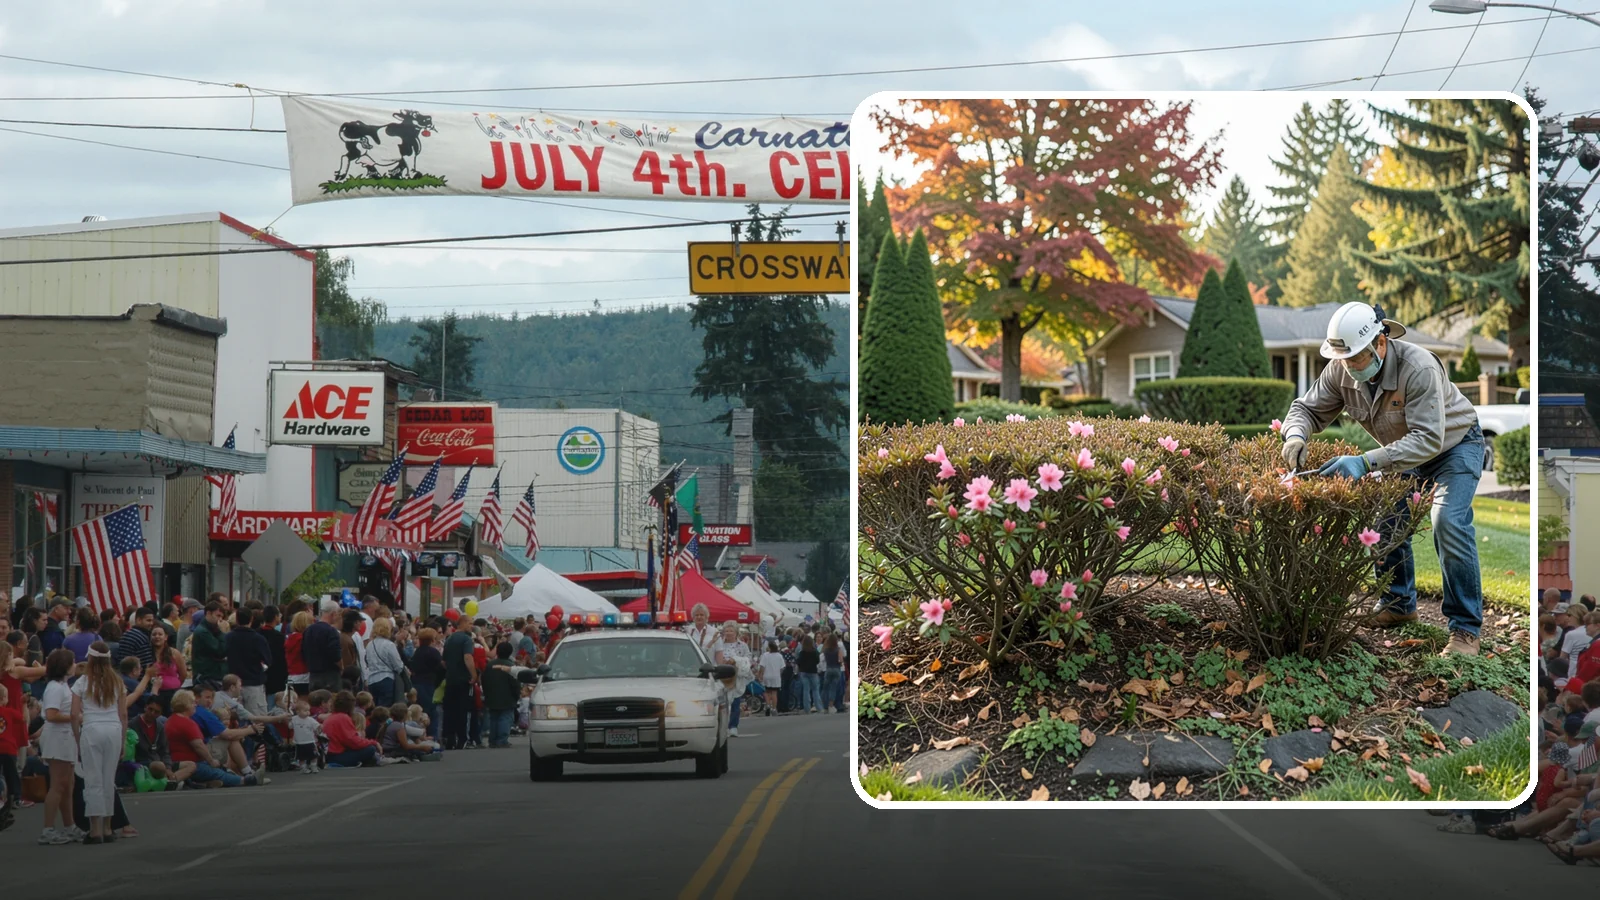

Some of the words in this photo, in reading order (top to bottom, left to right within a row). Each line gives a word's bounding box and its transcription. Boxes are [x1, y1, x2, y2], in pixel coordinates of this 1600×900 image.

[695, 121, 850, 150] Carnat
[481, 141, 604, 192] JULY
[632, 150, 746, 197] 4th.
[697, 254, 850, 280] CROSSWA
[283, 380, 373, 419] ACE
[405, 409, 452, 422] CEDAR
[284, 421, 370, 436] Hardware
[416, 428, 477, 446] Coca-Cola
[353, 467, 387, 481] Simpl
[95, 485, 124, 494] Vincent
[126, 486, 136, 494] de
[137, 486, 155, 495] Paul
[688, 527, 741, 535] CRNATION
[699, 535, 730, 543] GLASS
